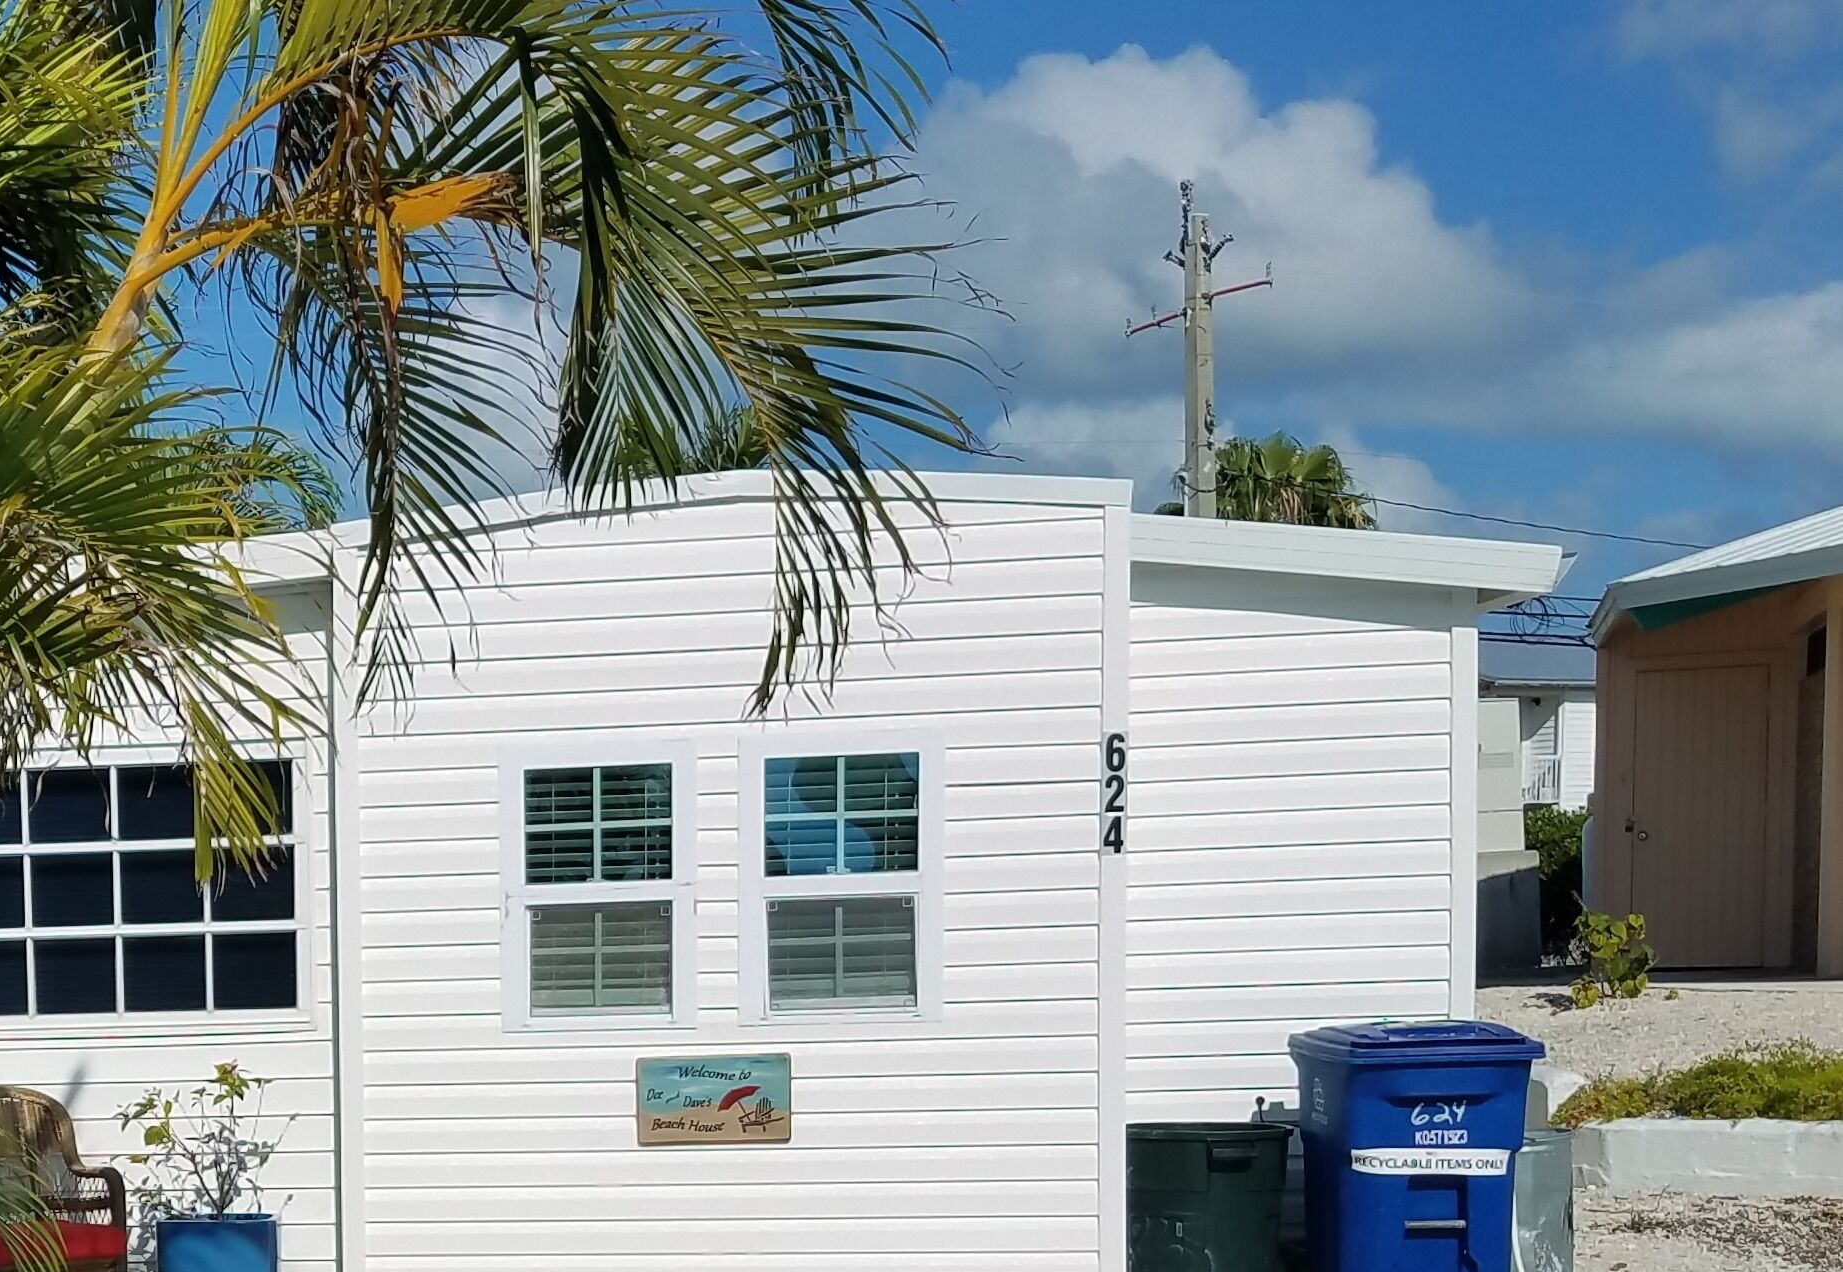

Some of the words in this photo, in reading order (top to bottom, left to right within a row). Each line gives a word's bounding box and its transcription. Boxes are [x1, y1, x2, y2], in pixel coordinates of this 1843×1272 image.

[1103, 733, 1125, 854] 624
[678, 1064, 736, 1081] Welcome
[738, 1068, 752, 1081] to
[682, 1096, 712, 1108] Dave's
[1410, 1100, 1467, 1126] 624
[651, 1116, 686, 1131] Beach
[688, 1121, 726, 1133] House
[1354, 1155, 1432, 1169] RECYCLABLE
[1435, 1158, 1473, 1169] ITEMS
[1475, 1158, 1504, 1170] ONLY
